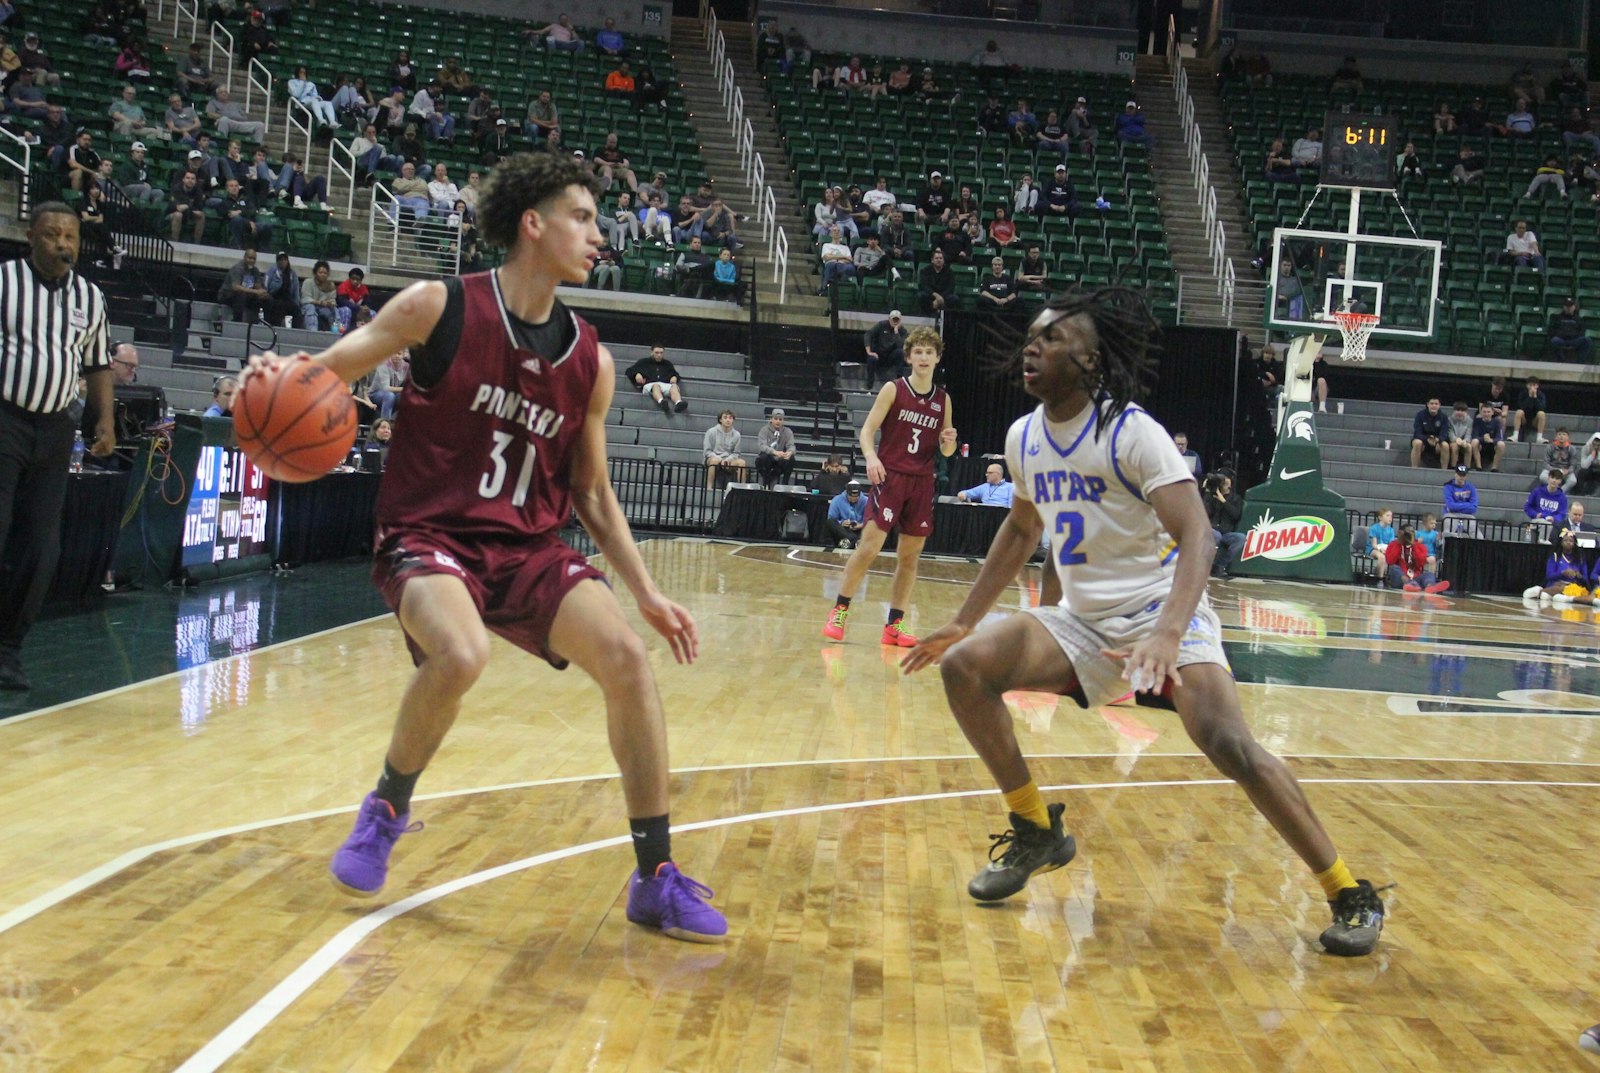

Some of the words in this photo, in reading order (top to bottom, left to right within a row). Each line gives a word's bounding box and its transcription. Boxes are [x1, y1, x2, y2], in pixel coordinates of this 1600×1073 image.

[644, 11, 661, 21] 135
[1118, 52, 1135, 60] 101
[1345, 126, 1386, 145] 6:11
[898, 409, 939, 430] PIONEERS
[907, 427, 922, 454] 3
[196, 446, 215, 491] 40
[220, 451, 245, 493] 6:11
[478, 430, 537, 507] 31
[183, 514, 201, 547] ATA
[252, 500, 268, 543] GR
[1055, 511, 1087, 566] 2
[1242, 525, 1326, 560] LIBMAN
